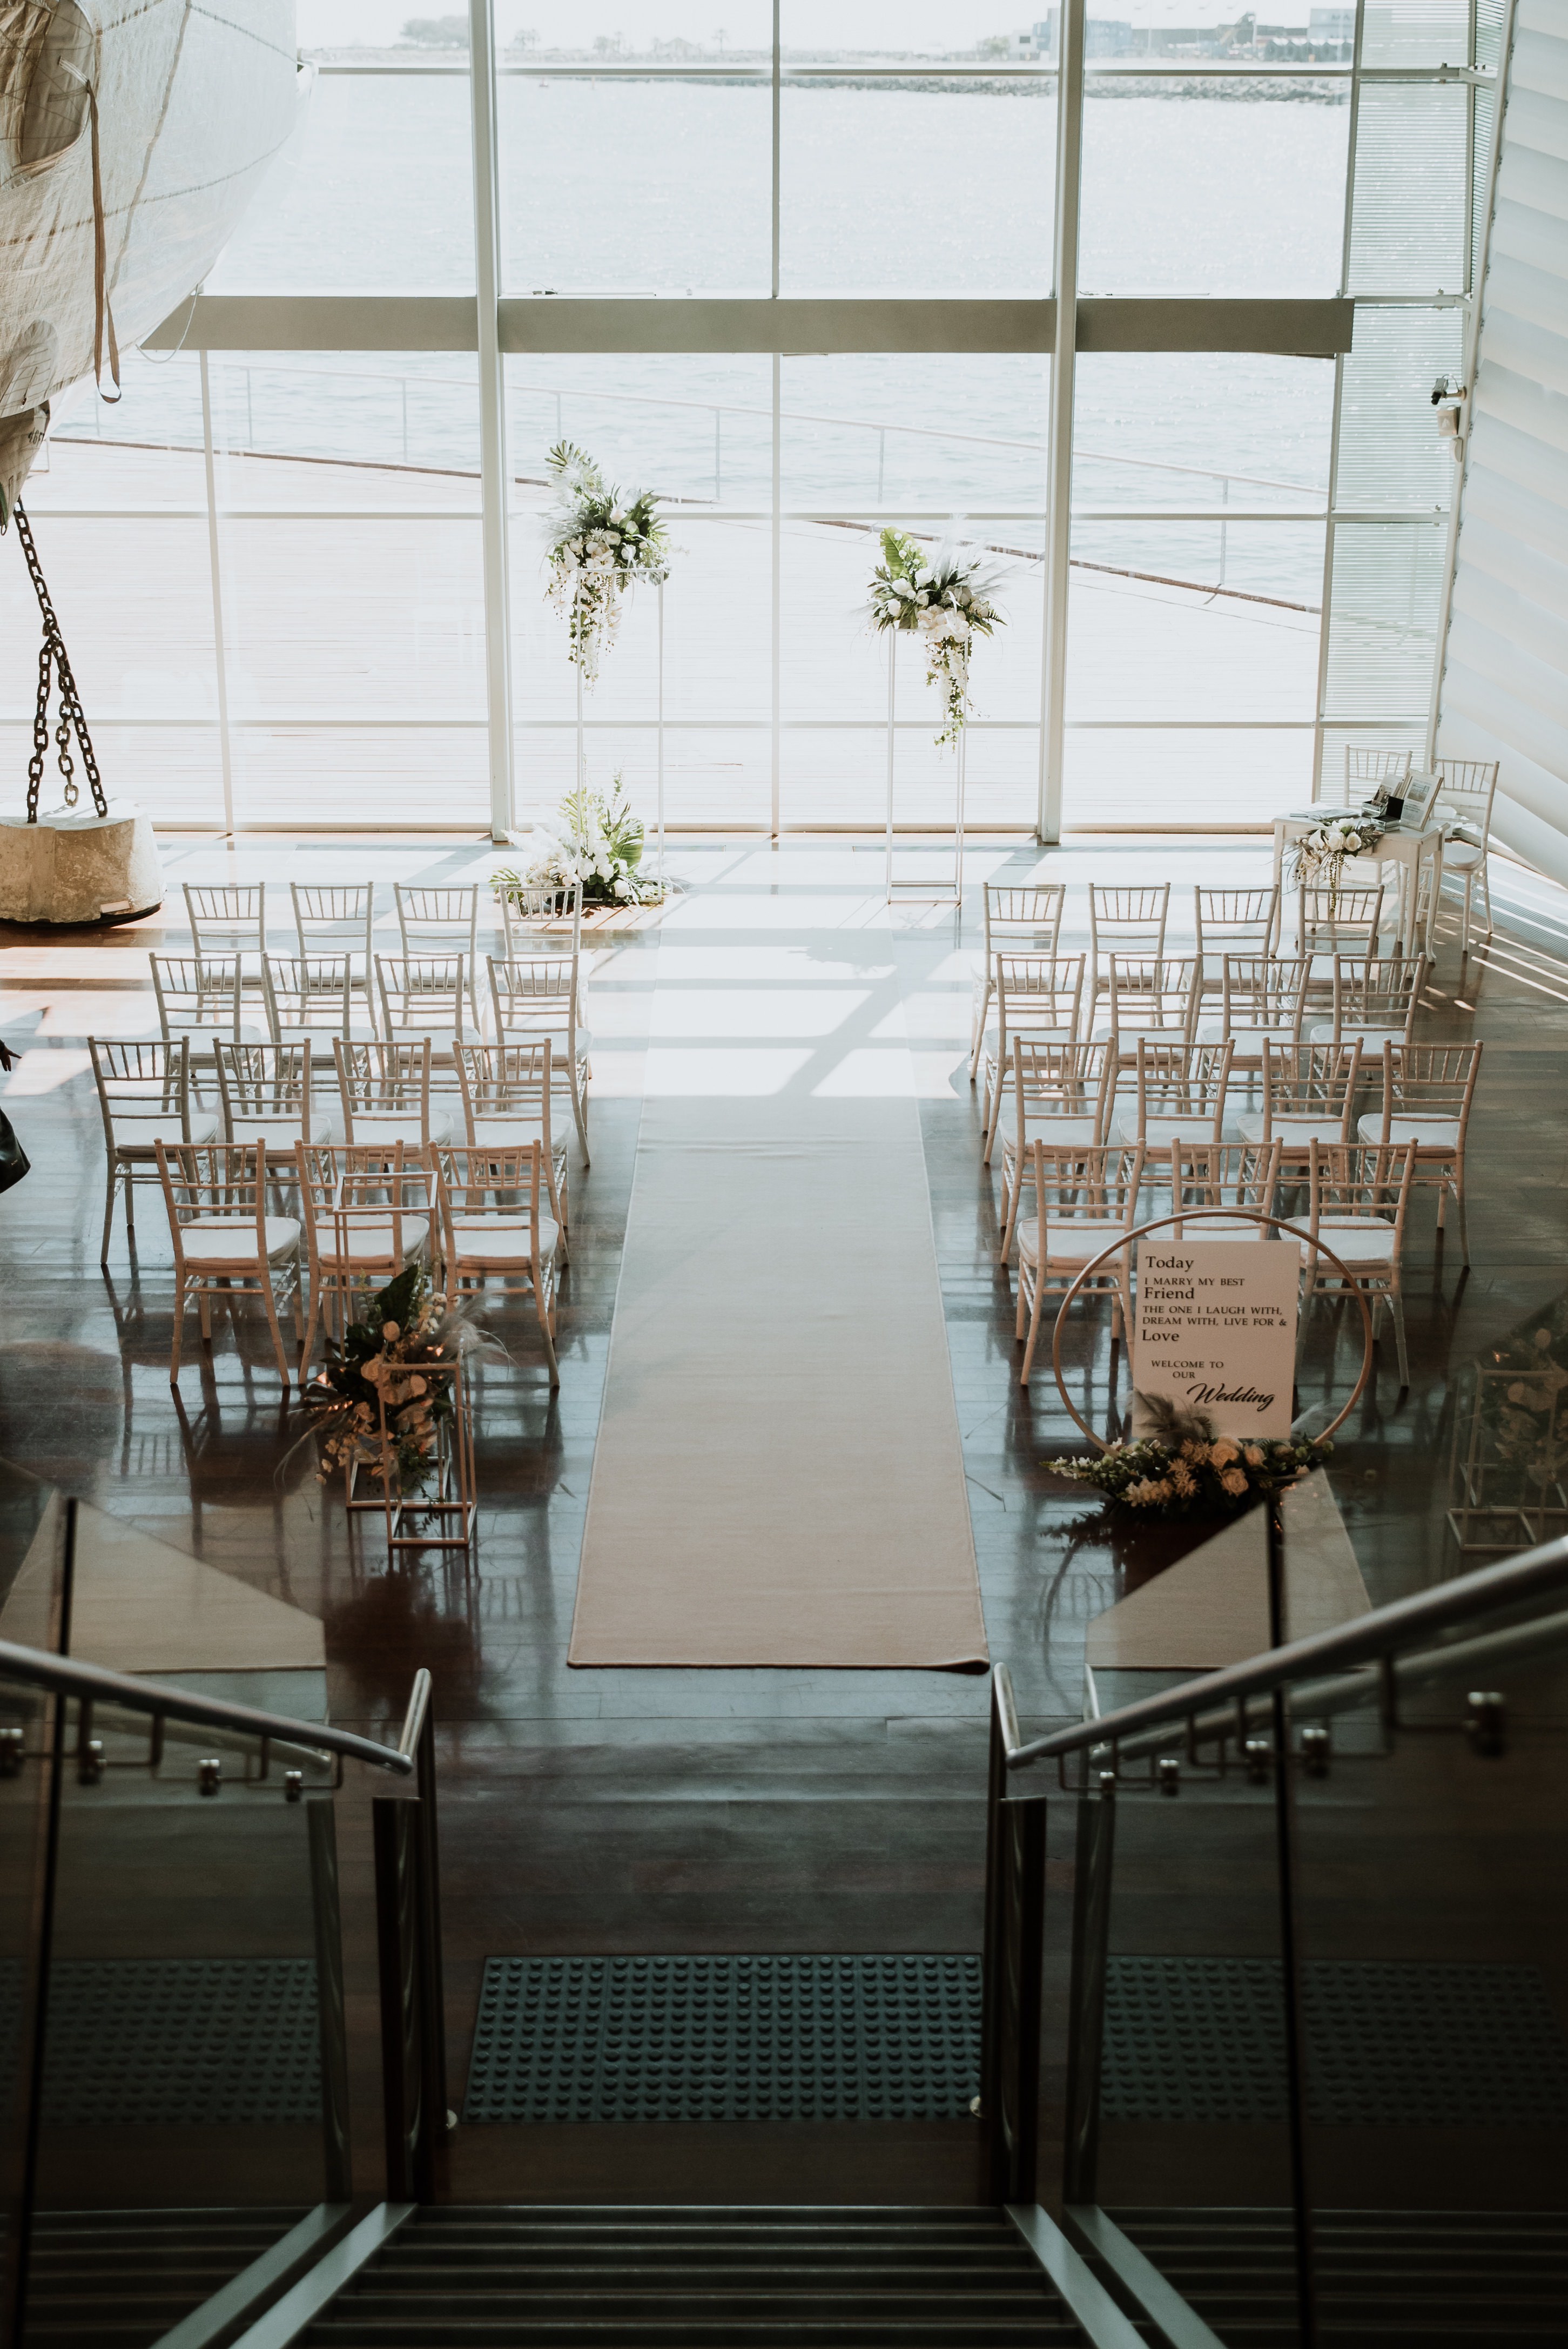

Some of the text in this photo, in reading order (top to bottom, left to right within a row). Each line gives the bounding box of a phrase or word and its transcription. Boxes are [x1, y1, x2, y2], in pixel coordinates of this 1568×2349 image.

[1146, 1256, 1194, 1272] Today
[1144, 1287, 1194, 1299] Friend
[1251, 1307, 1282, 1315] WITH,
[1187, 1317, 1219, 1326] WITH,
[1142, 1329, 1180, 1342] Love
[1186, 1383, 1275, 1412] Wedding
